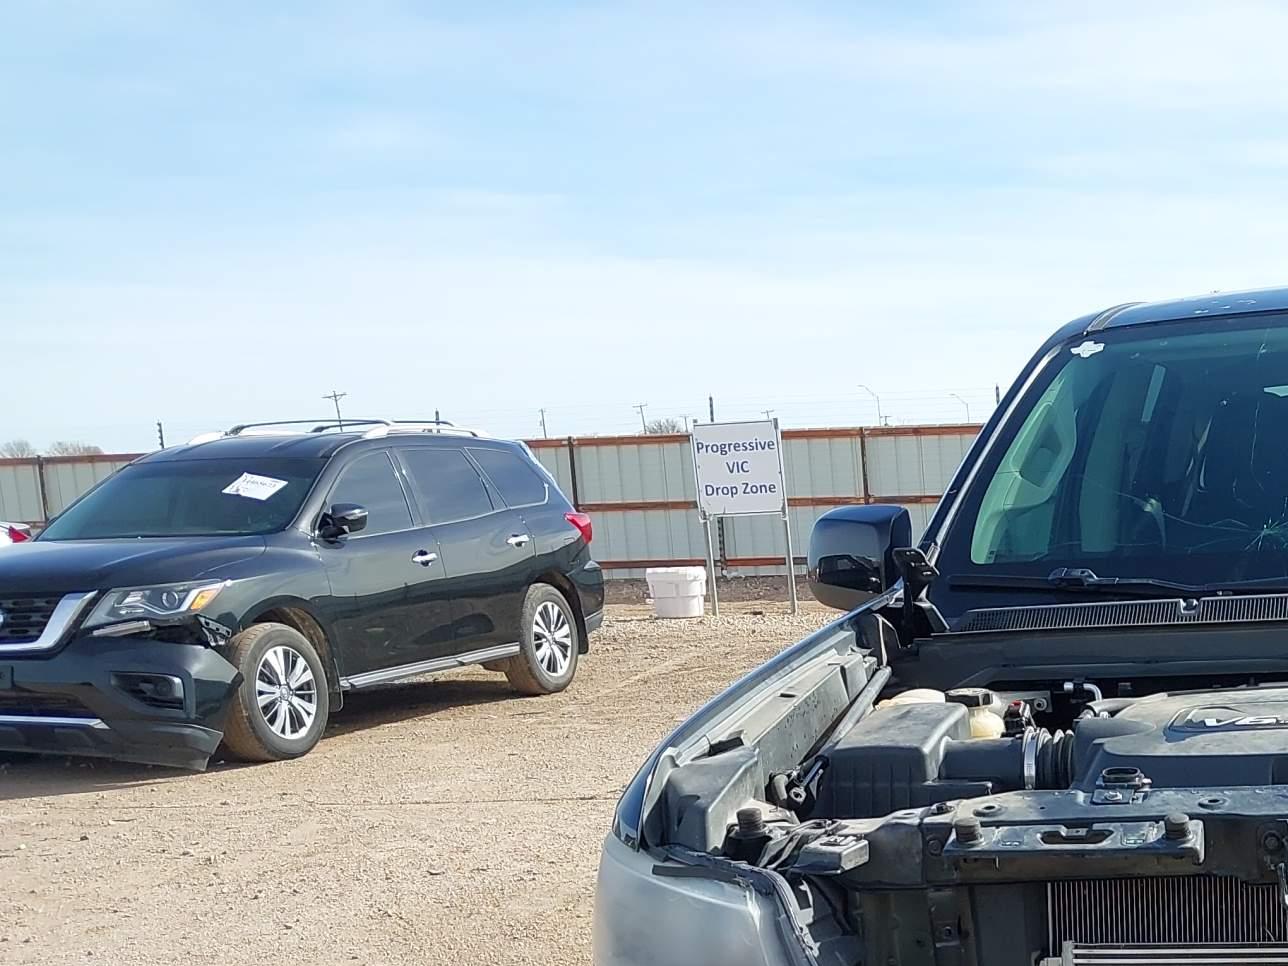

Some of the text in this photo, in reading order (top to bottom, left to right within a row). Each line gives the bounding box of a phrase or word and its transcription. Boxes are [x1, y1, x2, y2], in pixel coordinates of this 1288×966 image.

[696, 438, 776, 456] Progressive
[725, 460, 750, 474] VIC
[704, 482, 777, 499] Drop Zone
